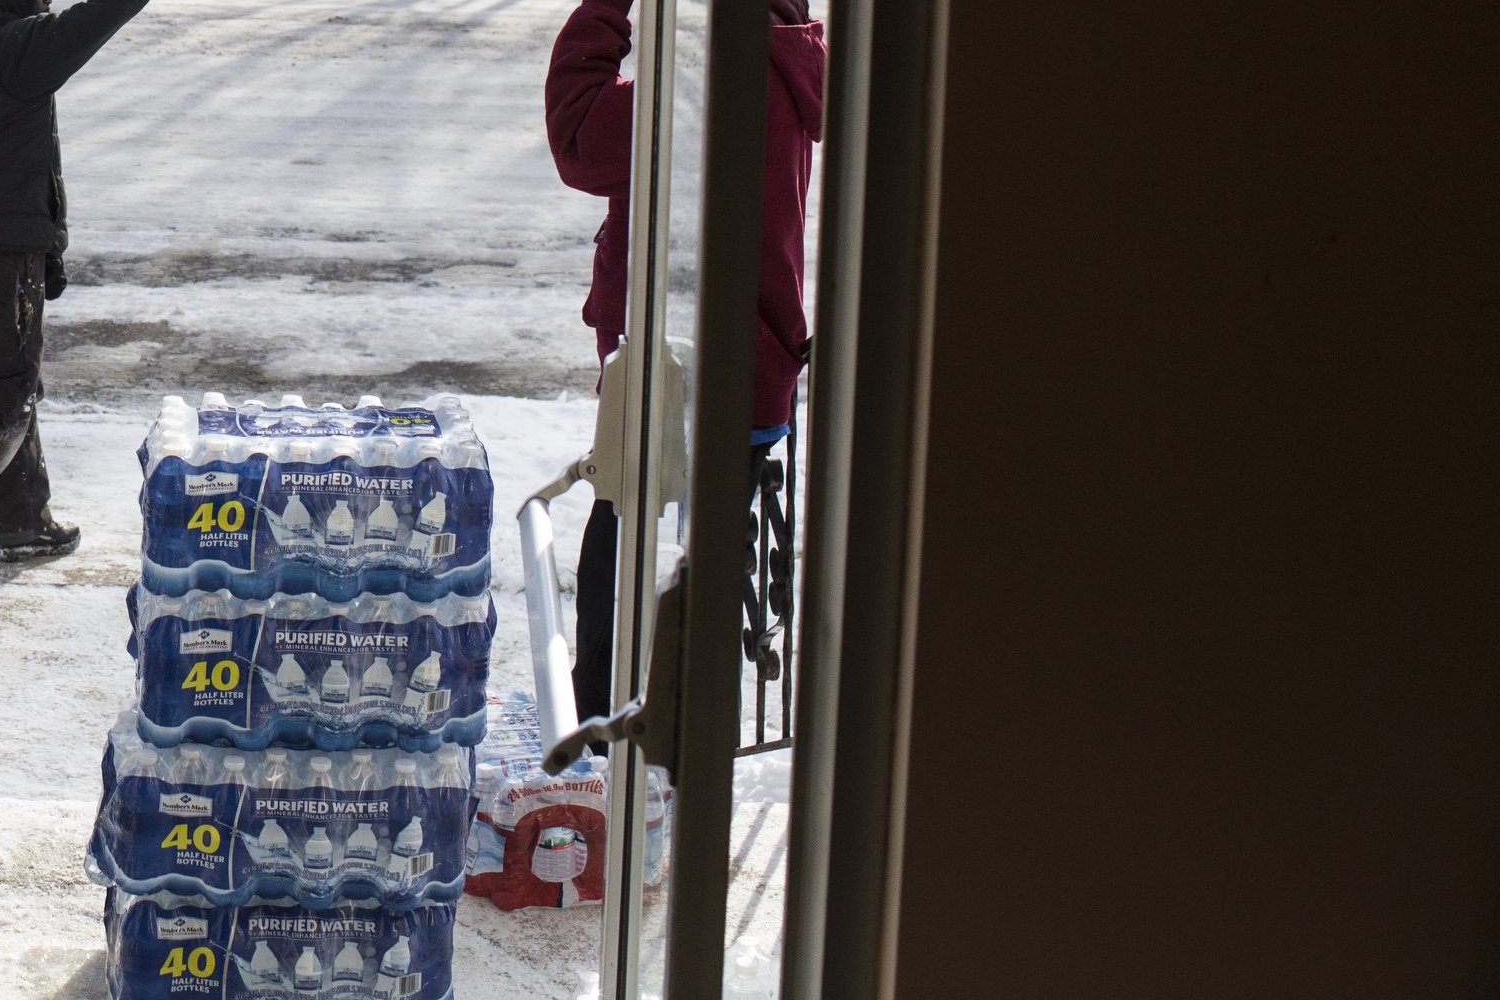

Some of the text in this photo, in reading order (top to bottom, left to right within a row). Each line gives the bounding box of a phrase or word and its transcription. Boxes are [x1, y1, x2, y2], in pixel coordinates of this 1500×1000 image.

[281, 473, 413, 490] PURIFIED WATER
[187, 500, 245, 533] 40
[200, 533, 249, 541] HALF LITER
[200, 540, 239, 548] BOTTLES
[275, 632, 409, 647] PURIFIED WATER
[181, 660, 240, 692] 40
[194, 691, 244, 700] HALF LITER
[193, 699, 234, 707] BOTTLES
[565, 779, 604, 795] BOTTLES
[255, 799, 389, 814] PURIFIED WATER
[266, 809, 300, 817] MINERAL
[160, 823, 221, 854] 40
[176, 851, 225, 863] HALF LITER
[176, 858, 215, 870] BOTTLES
[248, 918, 376, 934] PURIFIED WATER
[159, 946, 216, 978] 40
[171, 977, 220, 987] HALF LITER
[170, 984, 210, 994] BOTTLES
